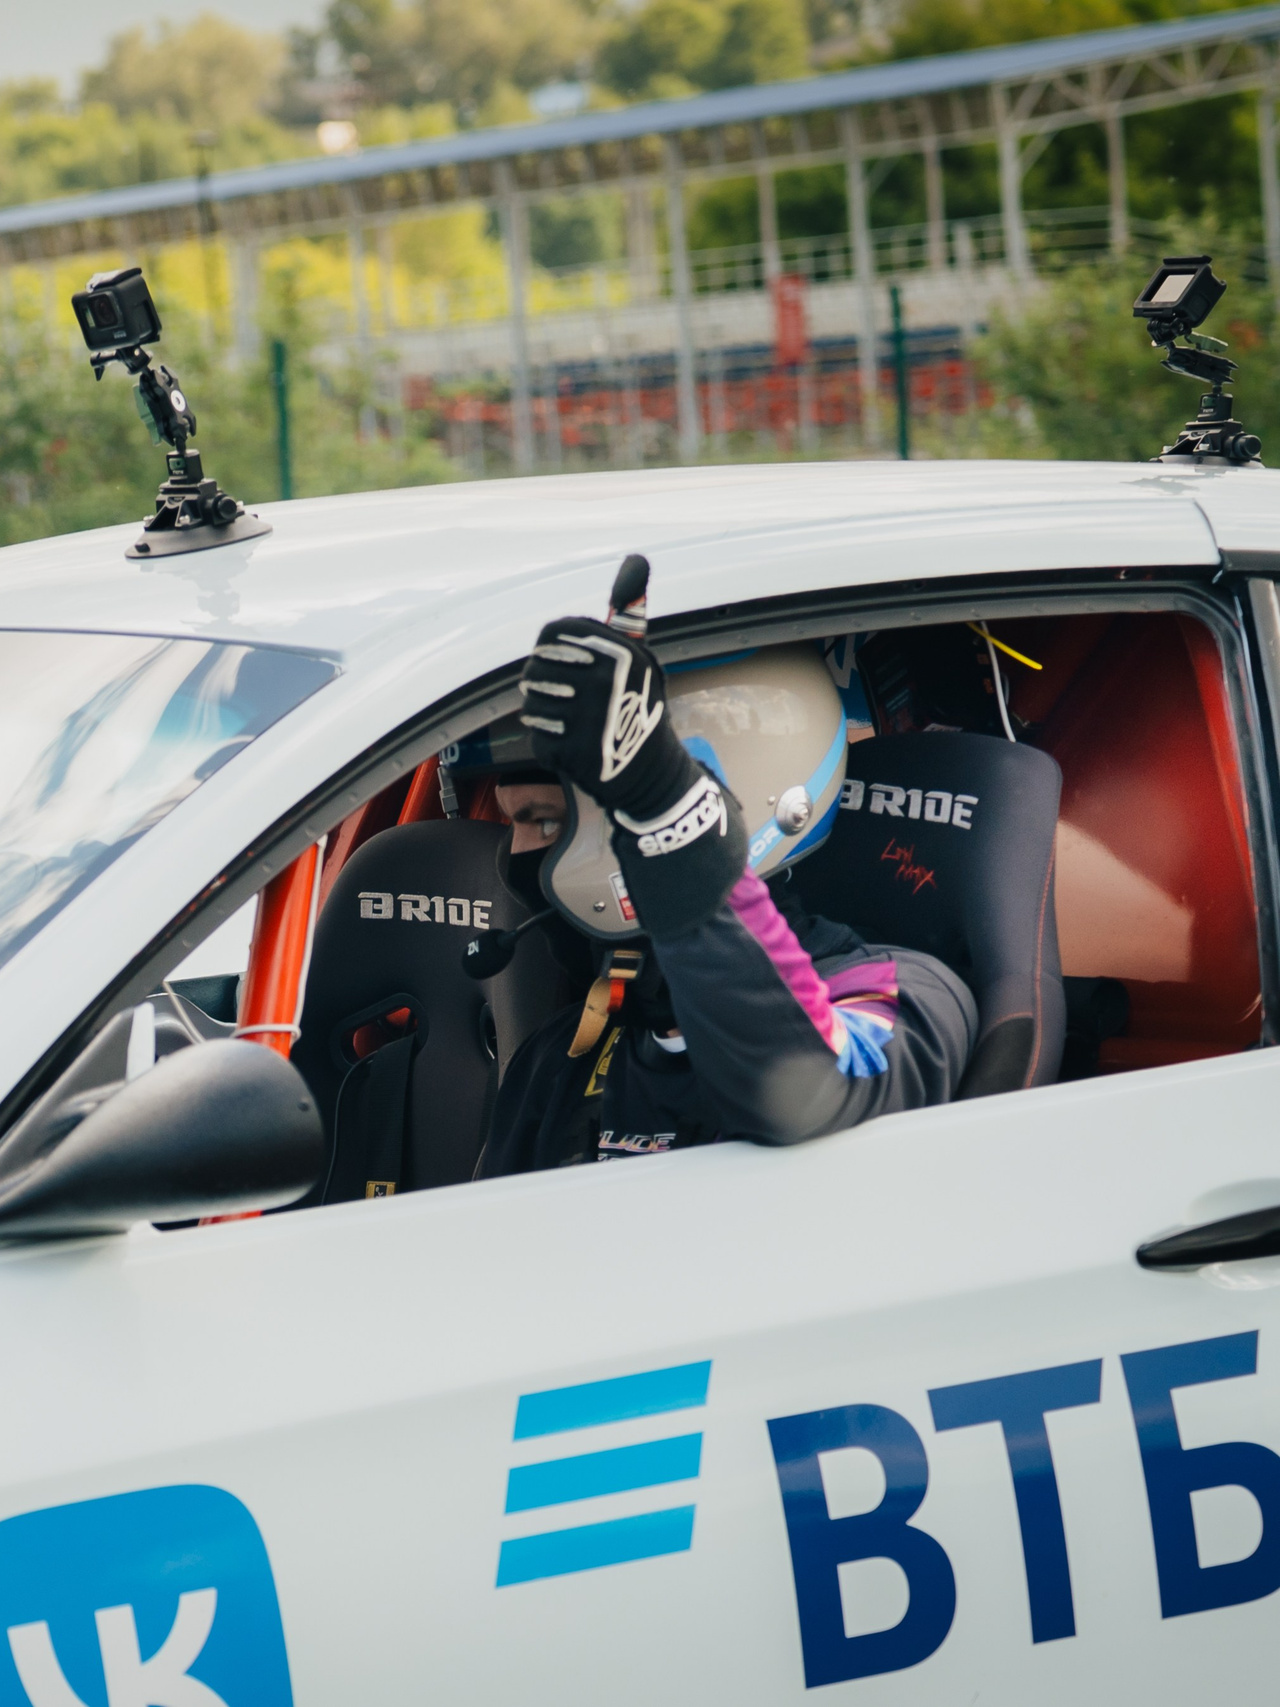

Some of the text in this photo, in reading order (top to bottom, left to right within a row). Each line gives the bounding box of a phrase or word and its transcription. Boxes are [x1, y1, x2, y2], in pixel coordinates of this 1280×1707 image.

[839, 778, 979, 830] BRIDE
[358, 891, 492, 930] BRIDE
[766, 1329, 1280, 1690] ВТБ
